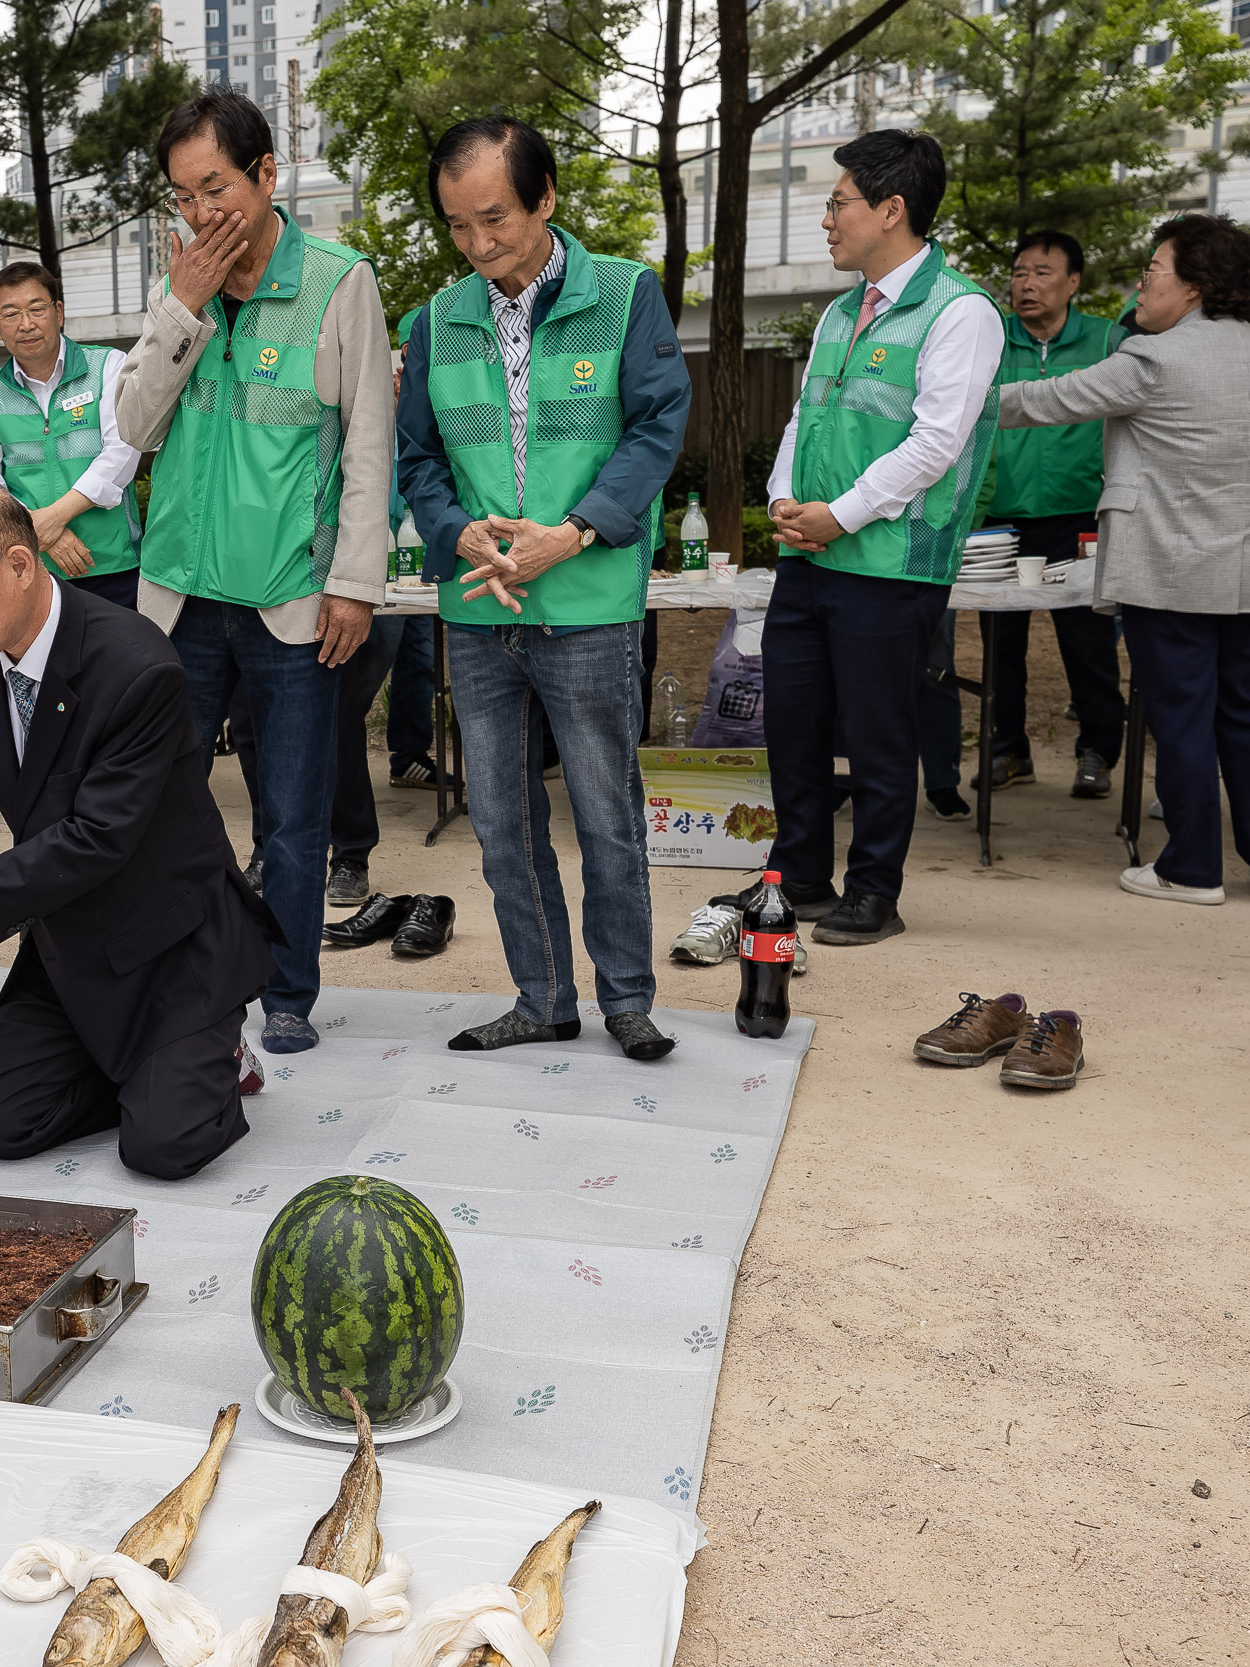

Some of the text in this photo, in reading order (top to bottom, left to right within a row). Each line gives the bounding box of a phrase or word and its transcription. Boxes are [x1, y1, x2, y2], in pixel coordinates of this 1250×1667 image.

[251, 366, 278, 381] SMU
[863, 364, 884, 376] SMU
[569, 383, 597, 394] SMU
[70, 418, 89, 428] SMU
